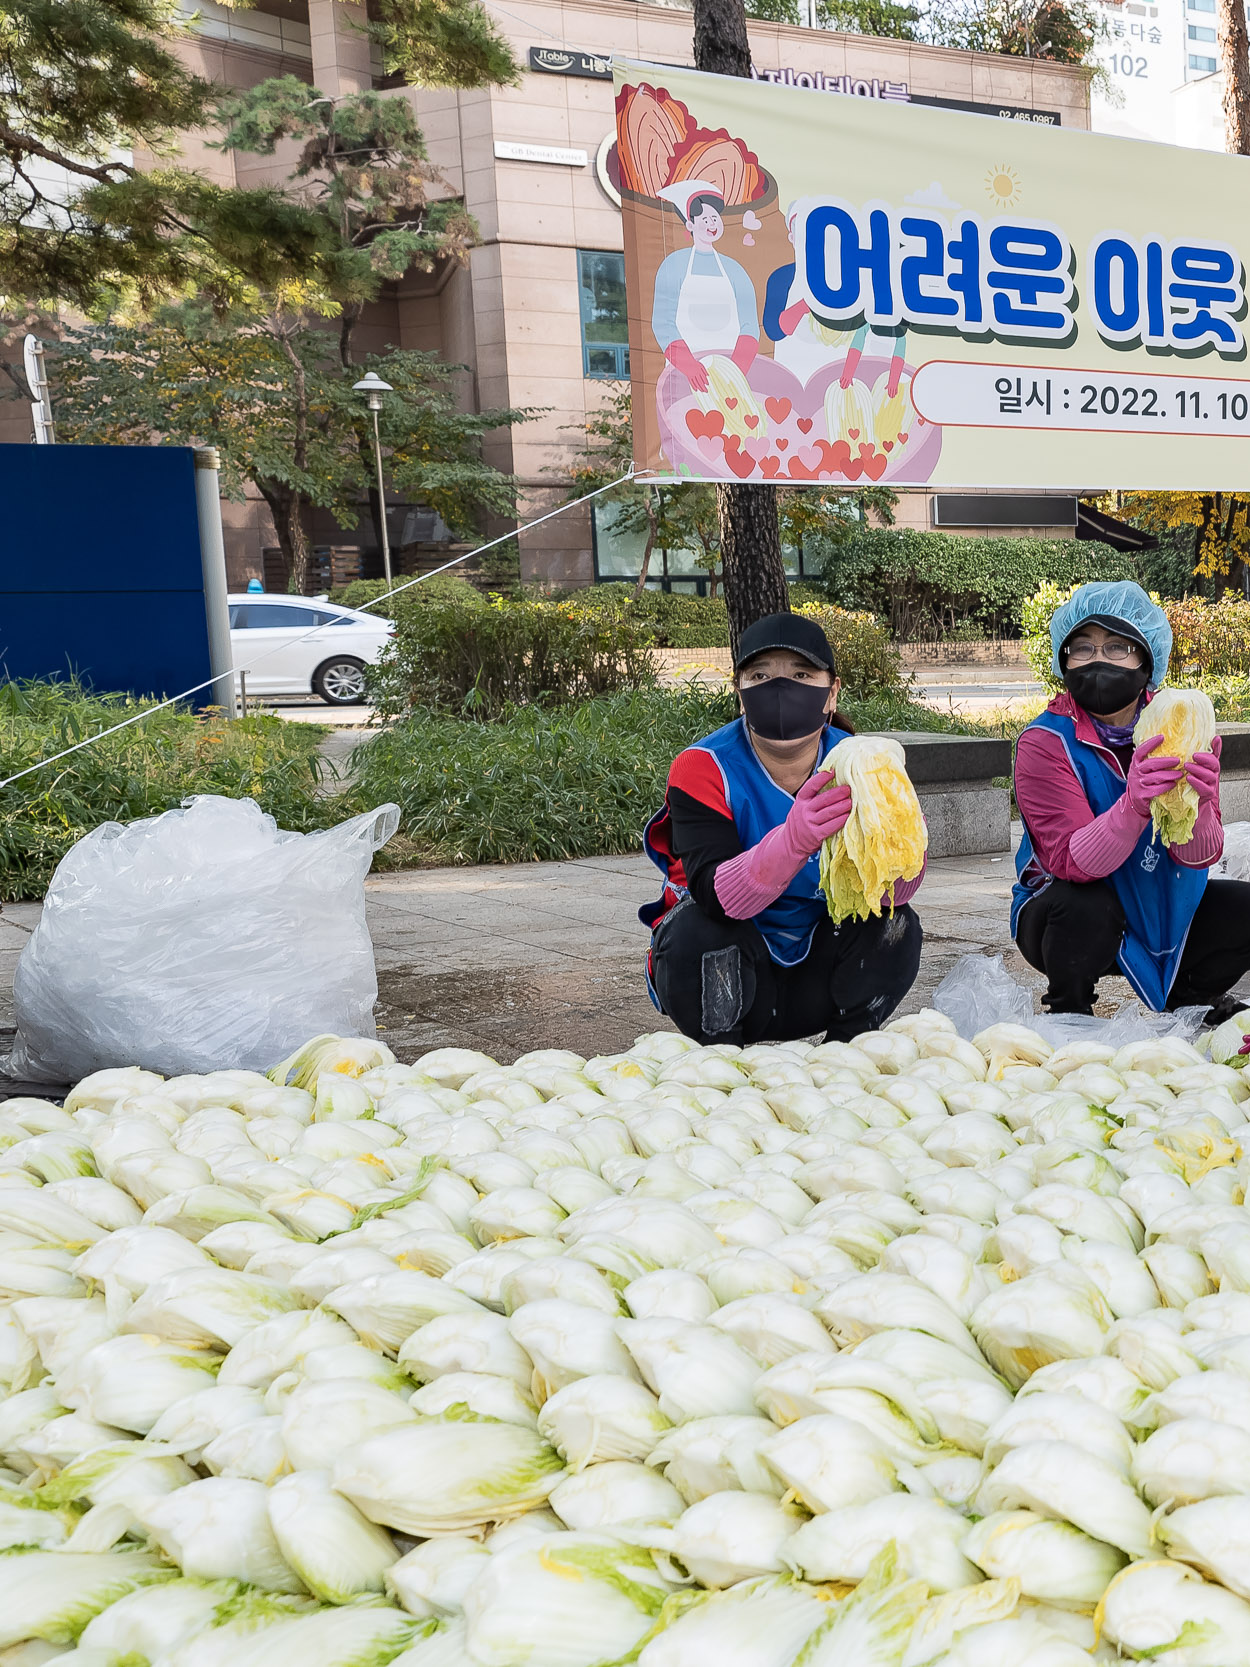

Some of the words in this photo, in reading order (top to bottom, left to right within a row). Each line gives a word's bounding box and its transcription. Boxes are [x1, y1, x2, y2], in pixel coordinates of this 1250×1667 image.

[1109, 54, 1148, 78] 102
[526, 150, 553, 158] Dental
[555, 152, 582, 161] Center
[806, 205, 1066, 329] 어려운
[1094, 238, 1237, 342] 이웃
[994, 377, 1052, 415] 일시
